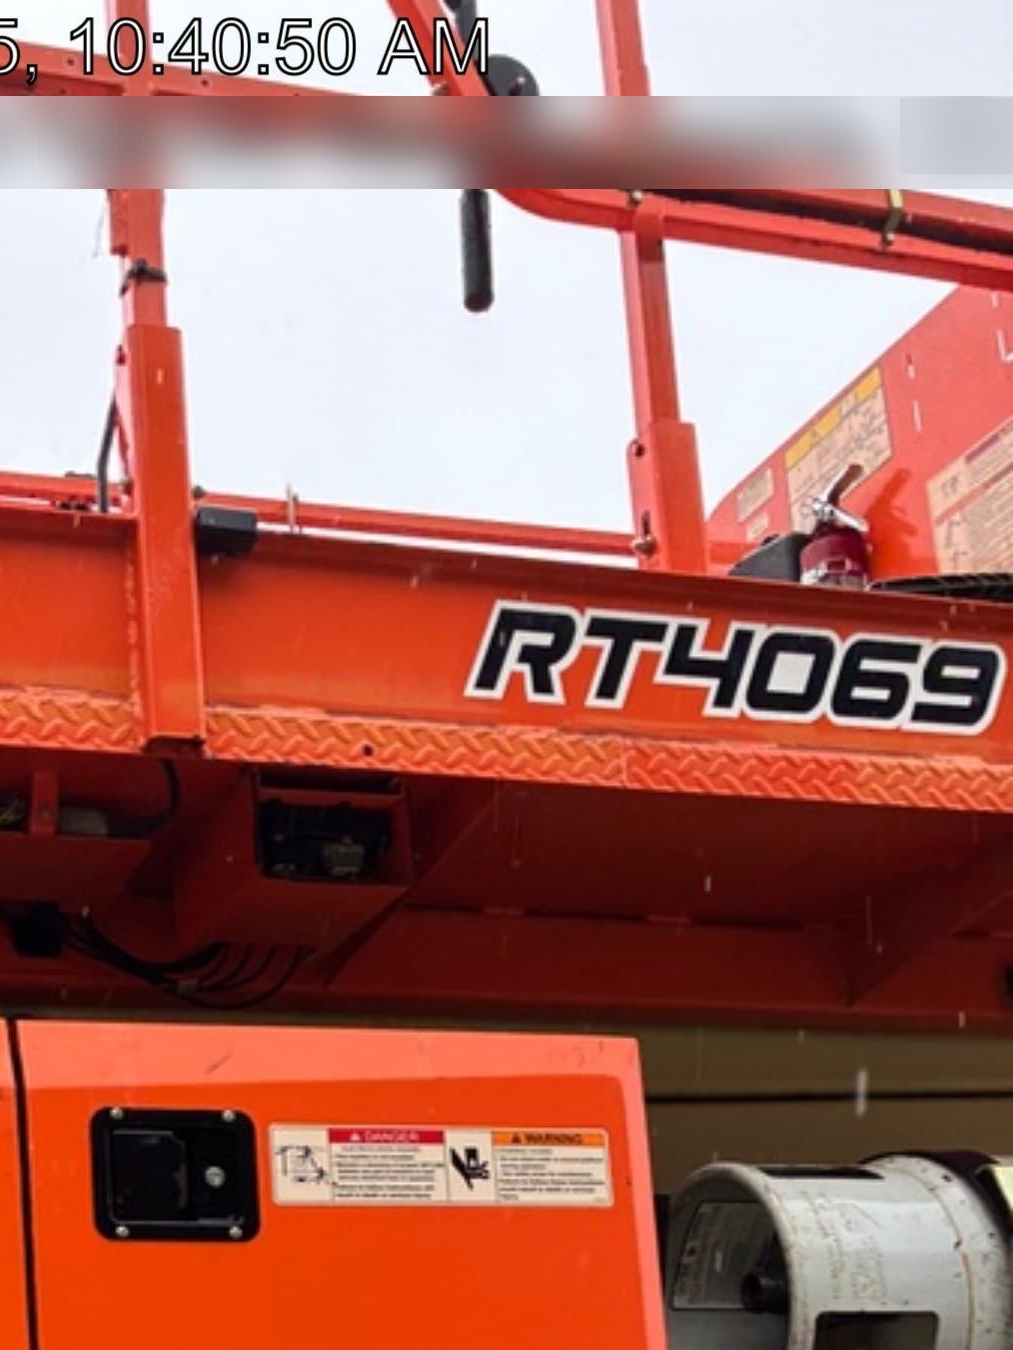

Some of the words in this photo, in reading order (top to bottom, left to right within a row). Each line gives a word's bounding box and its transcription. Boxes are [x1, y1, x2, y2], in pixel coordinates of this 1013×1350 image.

[466, 600, 1006, 735] RT4069
[364, 1130, 421, 1141] DANGER
[525, 1134, 583, 1145] WARNING
